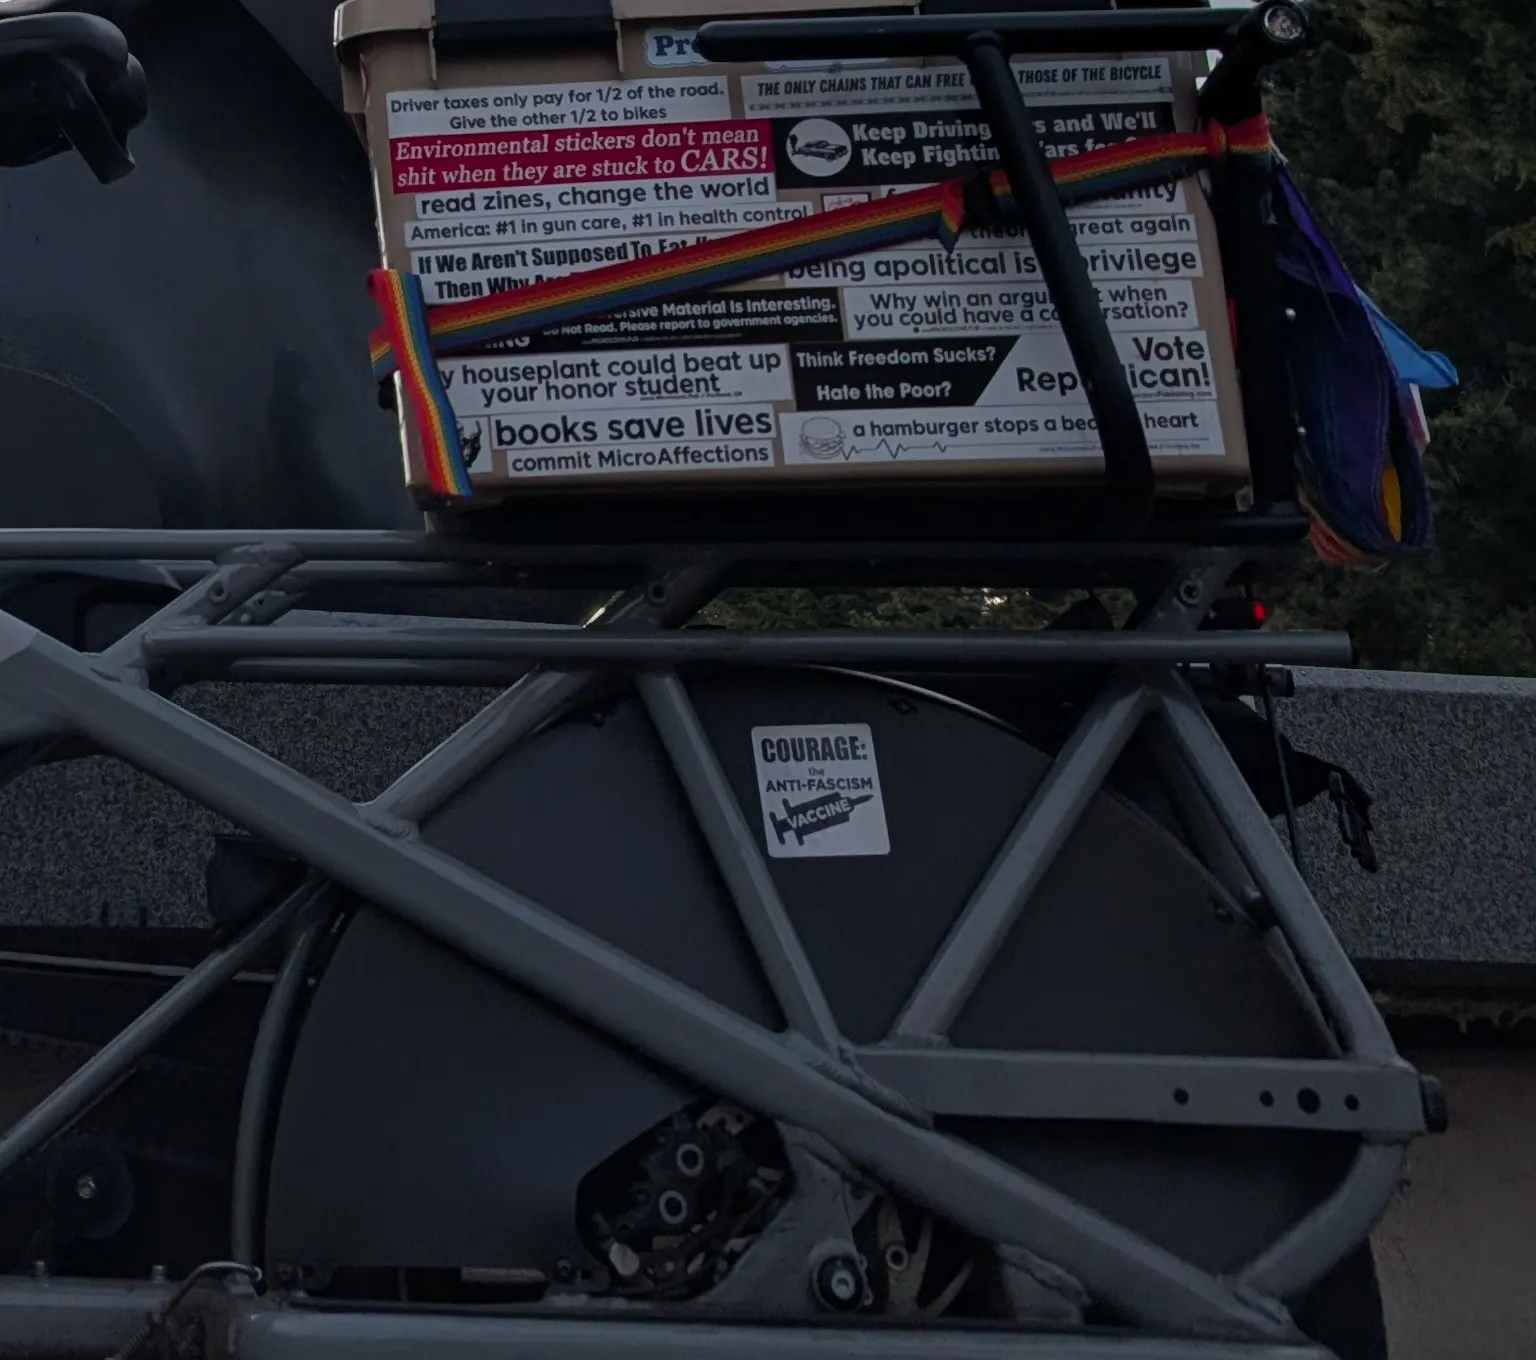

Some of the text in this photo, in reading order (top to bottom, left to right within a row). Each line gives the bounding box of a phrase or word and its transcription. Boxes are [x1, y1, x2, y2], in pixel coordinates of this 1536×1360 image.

[758, 65, 1162, 97] THE ONLY CHAINS THAT CAN FREE THOSE OF THE BICYCLE
[391, 83, 724, 113] Driver taxes only pay for 1/2 of the road.
[449, 105, 666, 130] Give the other 1/2 to bikes
[852, 122, 907, 144] Keep
[913, 118, 992, 141] Driving
[1053, 113, 1095, 133] and
[1099, 111, 1157, 130] We'll
[396, 126, 759, 161] Environmental stickers don't mean
[863, 148, 917, 168] Keep
[923, 144, 1000, 167] Fightin
[1038, 139, 1080, 158] ars
[397, 146, 768, 187] shit when they are stuck to CARS!
[421, 177, 769, 214] read zines, change the world
[411, 203, 809, 241] America: #1 in gun care, #1 in health control
[1130, 214, 1191, 235] again
[418, 257, 433, 275] If
[435, 254, 466, 272] We
[471, 248, 528, 271] Aren't
[532, 242, 627, 266] Supposed
[633, 241, 652, 259] To
[875, 252, 1005, 279] apolitical
[1014, 255, 1037, 274] is
[1081, 246, 1197, 273] rivilege
[435, 281, 482, 299] Then
[870, 293, 918, 314] Why
[924, 290, 961, 308] win
[966, 292, 992, 308] an
[1108, 285, 1167, 302] when
[663, 298, 727, 317] Material
[730, 299, 743, 313] Is
[747, 297, 836, 313] Interesting.
[855, 311, 894, 330] you
[900, 305, 959, 327] could
[964, 303, 1014, 324] have
[1020, 308, 1034, 322] a
[584, 322, 618, 333] Read.
[620, 320, 656, 332] Please
[660, 319, 694, 332] report
[698, 319, 709, 329] to
[714, 316, 781, 330] government
[784, 313, 838, 326] agencies.
[796, 345, 996, 368] Think Freedom Sucks?
[1133, 336, 1205, 361] Vote
[463, 358, 600, 385] houseplant
[607, 354, 676, 377] could
[684, 351, 741, 373] beat
[749, 353, 781, 373] up
[481, 385, 537, 408] your
[546, 379, 617, 401] honor
[625, 373, 720, 396] student
[816, 381, 951, 402] Hate the Poor?
[495, 408, 772, 446] books save lives
[853, 423, 865, 436] a
[871, 417, 978, 441] hamburger
[984, 414, 1038, 434] stops
[1044, 417, 1056, 431] a
[1143, 411, 1199, 429] heart
[512, 443, 768, 472] commit MicroAffections
[761, 736, 868, 763] COURAGE:
[766, 777, 874, 792] ANTI-FASCISM
[808, 768, 825, 776] the
[787, 798, 851, 829] VACCINE
